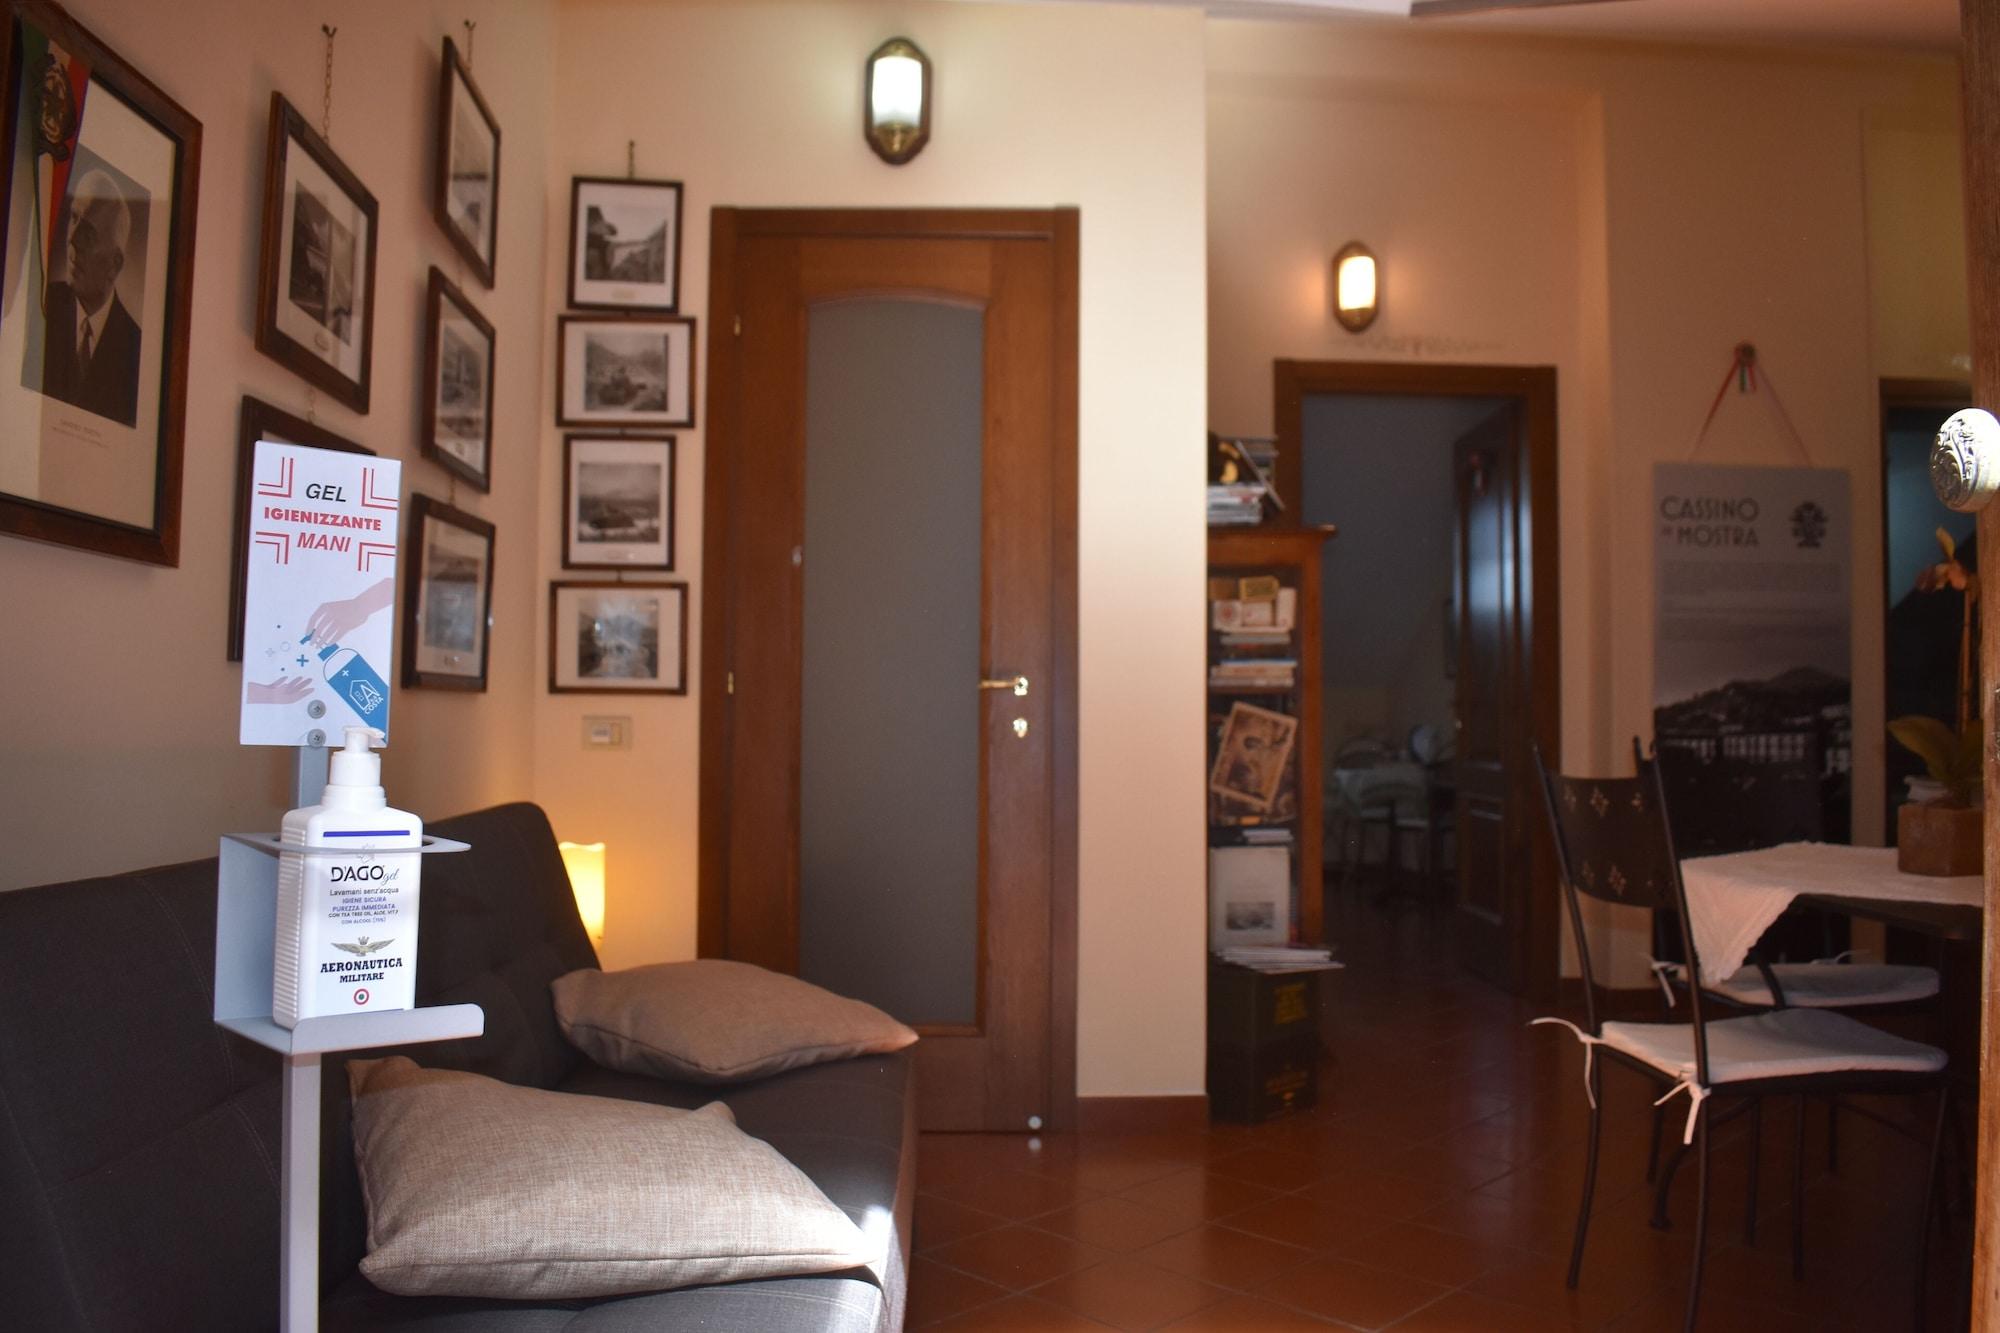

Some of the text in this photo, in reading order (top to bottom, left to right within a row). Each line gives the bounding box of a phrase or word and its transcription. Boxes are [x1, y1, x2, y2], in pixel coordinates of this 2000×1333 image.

[305, 483, 347, 503] GEL
[264, 507, 382, 531] IGIENIZZANTE
[1660, 495, 1760, 523] CASSINO
[297, 532, 351, 553] MANI
[1677, 524, 1760, 548] MOSTRA
[330, 865, 399, 886] D'AGO gel
[364, 887, 399, 896] senz'acqua
[320, 957, 403, 973] AERONAUTICA
[339, 971, 385, 983] MILITARE
